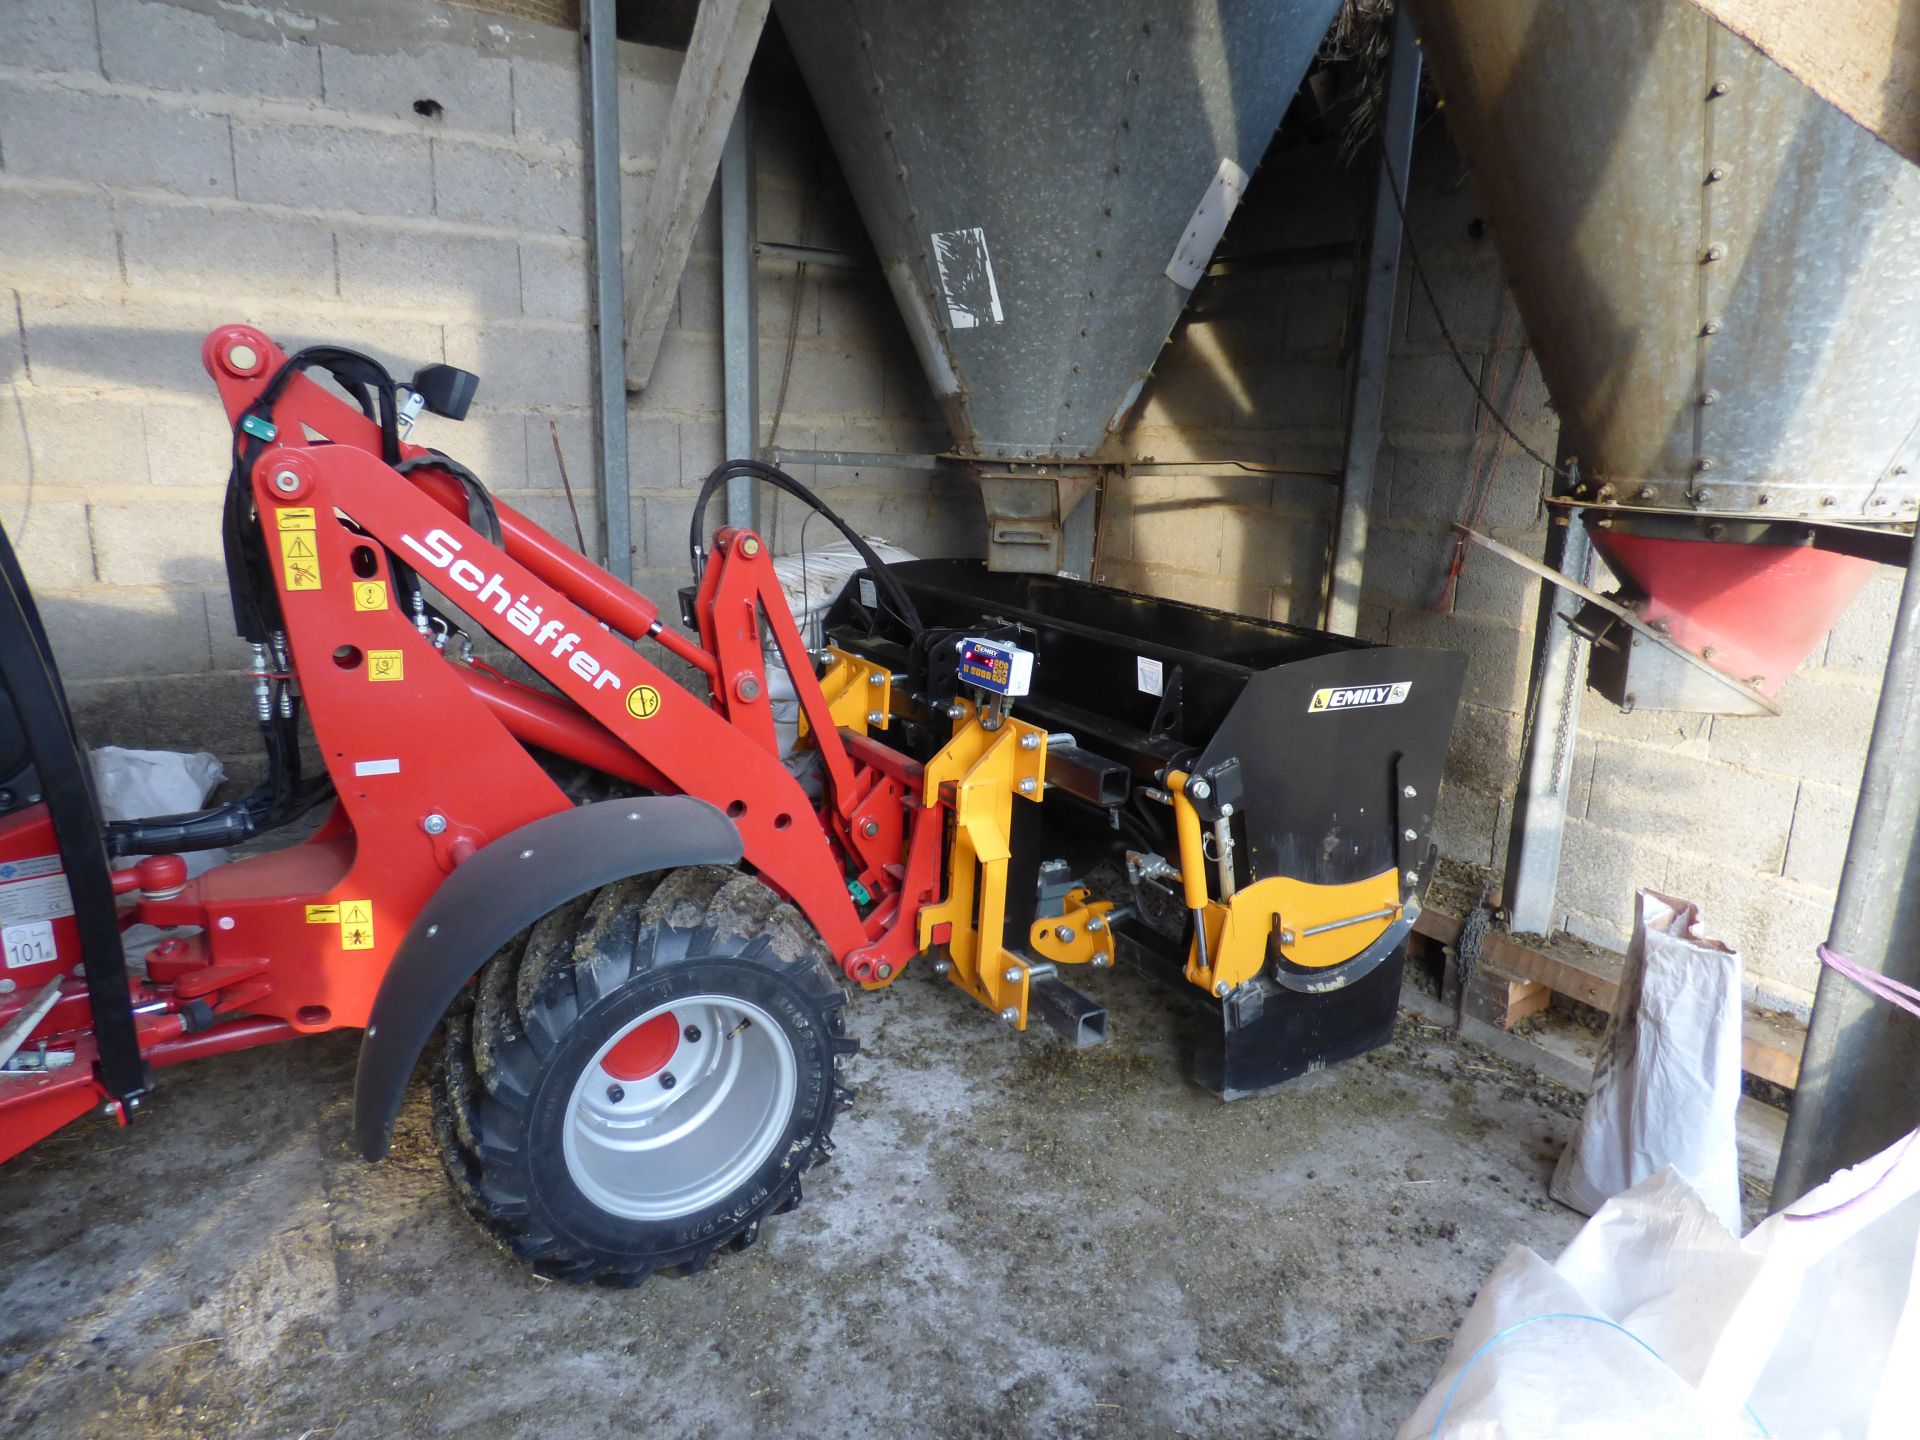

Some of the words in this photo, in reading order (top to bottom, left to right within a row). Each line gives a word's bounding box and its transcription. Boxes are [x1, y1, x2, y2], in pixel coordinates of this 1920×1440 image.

[401, 529, 621, 690] Schäffer
[980, 647, 998, 656] EMILY
[1330, 688, 1390, 706] EMILY
[10, 941, 44, 963] 101
